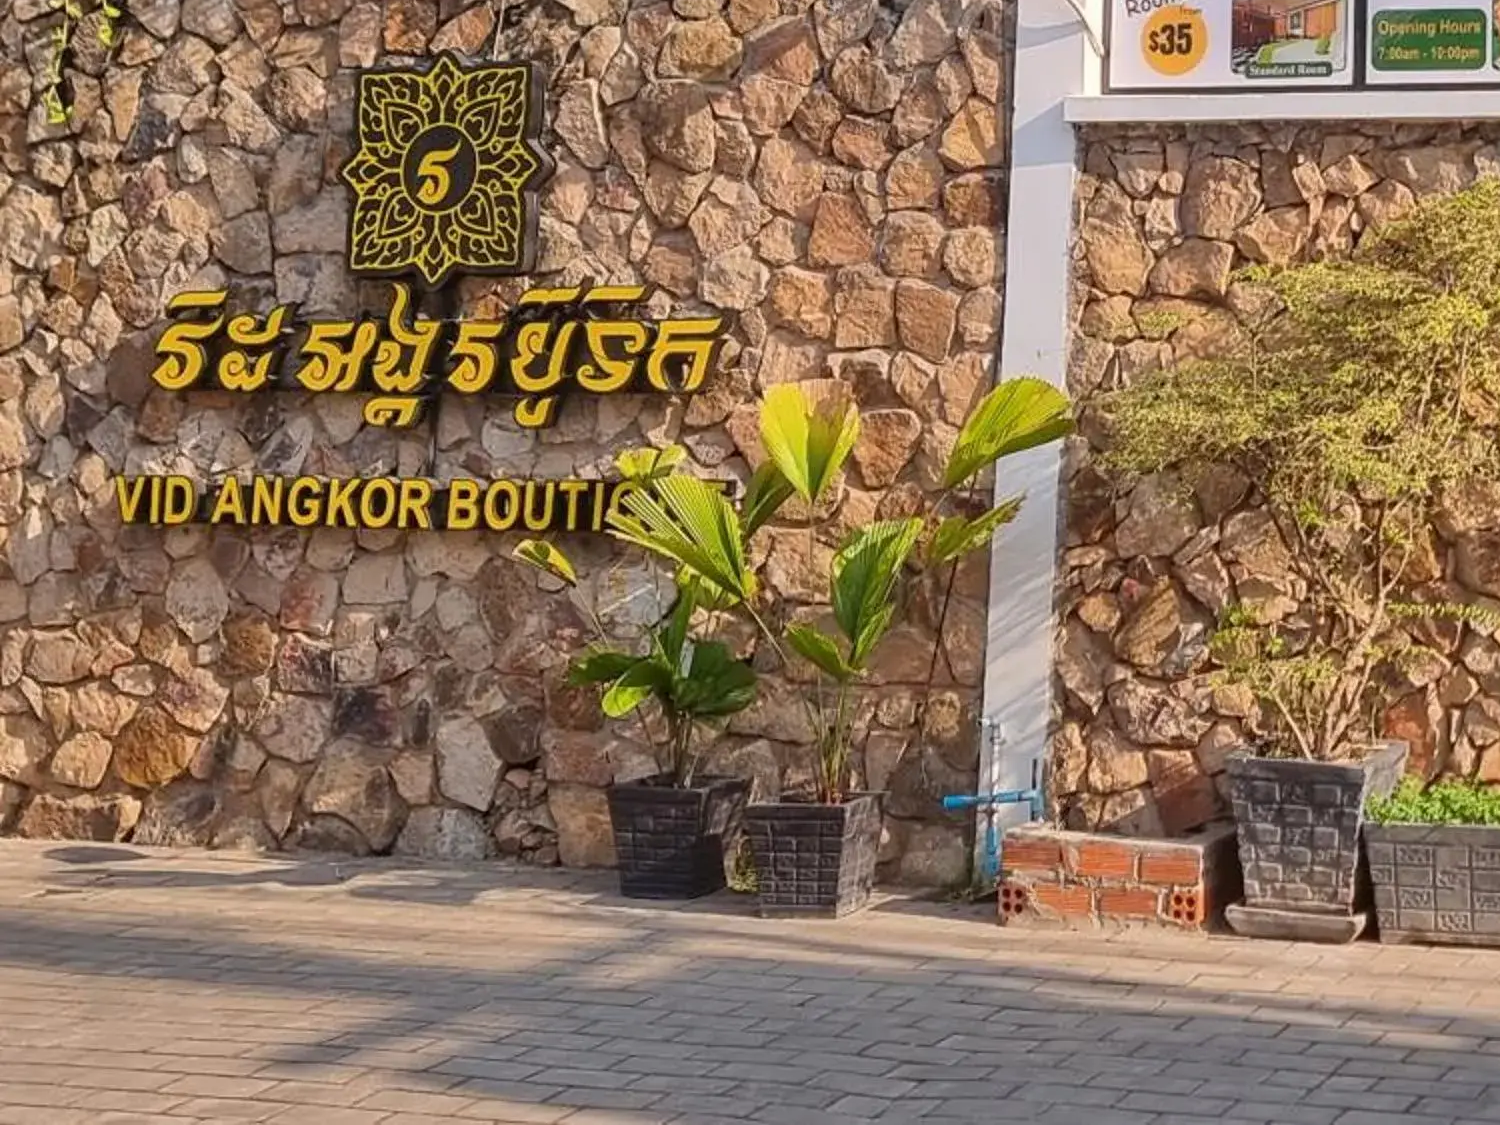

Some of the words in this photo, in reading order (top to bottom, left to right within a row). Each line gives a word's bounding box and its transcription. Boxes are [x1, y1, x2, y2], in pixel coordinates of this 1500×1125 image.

[1148, 23, 1193, 56] $35
[1377, 20, 1437, 38] Opening
[1440, 19, 1482, 35] Hours
[116, 475, 195, 524] VID
[211, 476, 433, 529] ANGKOR
